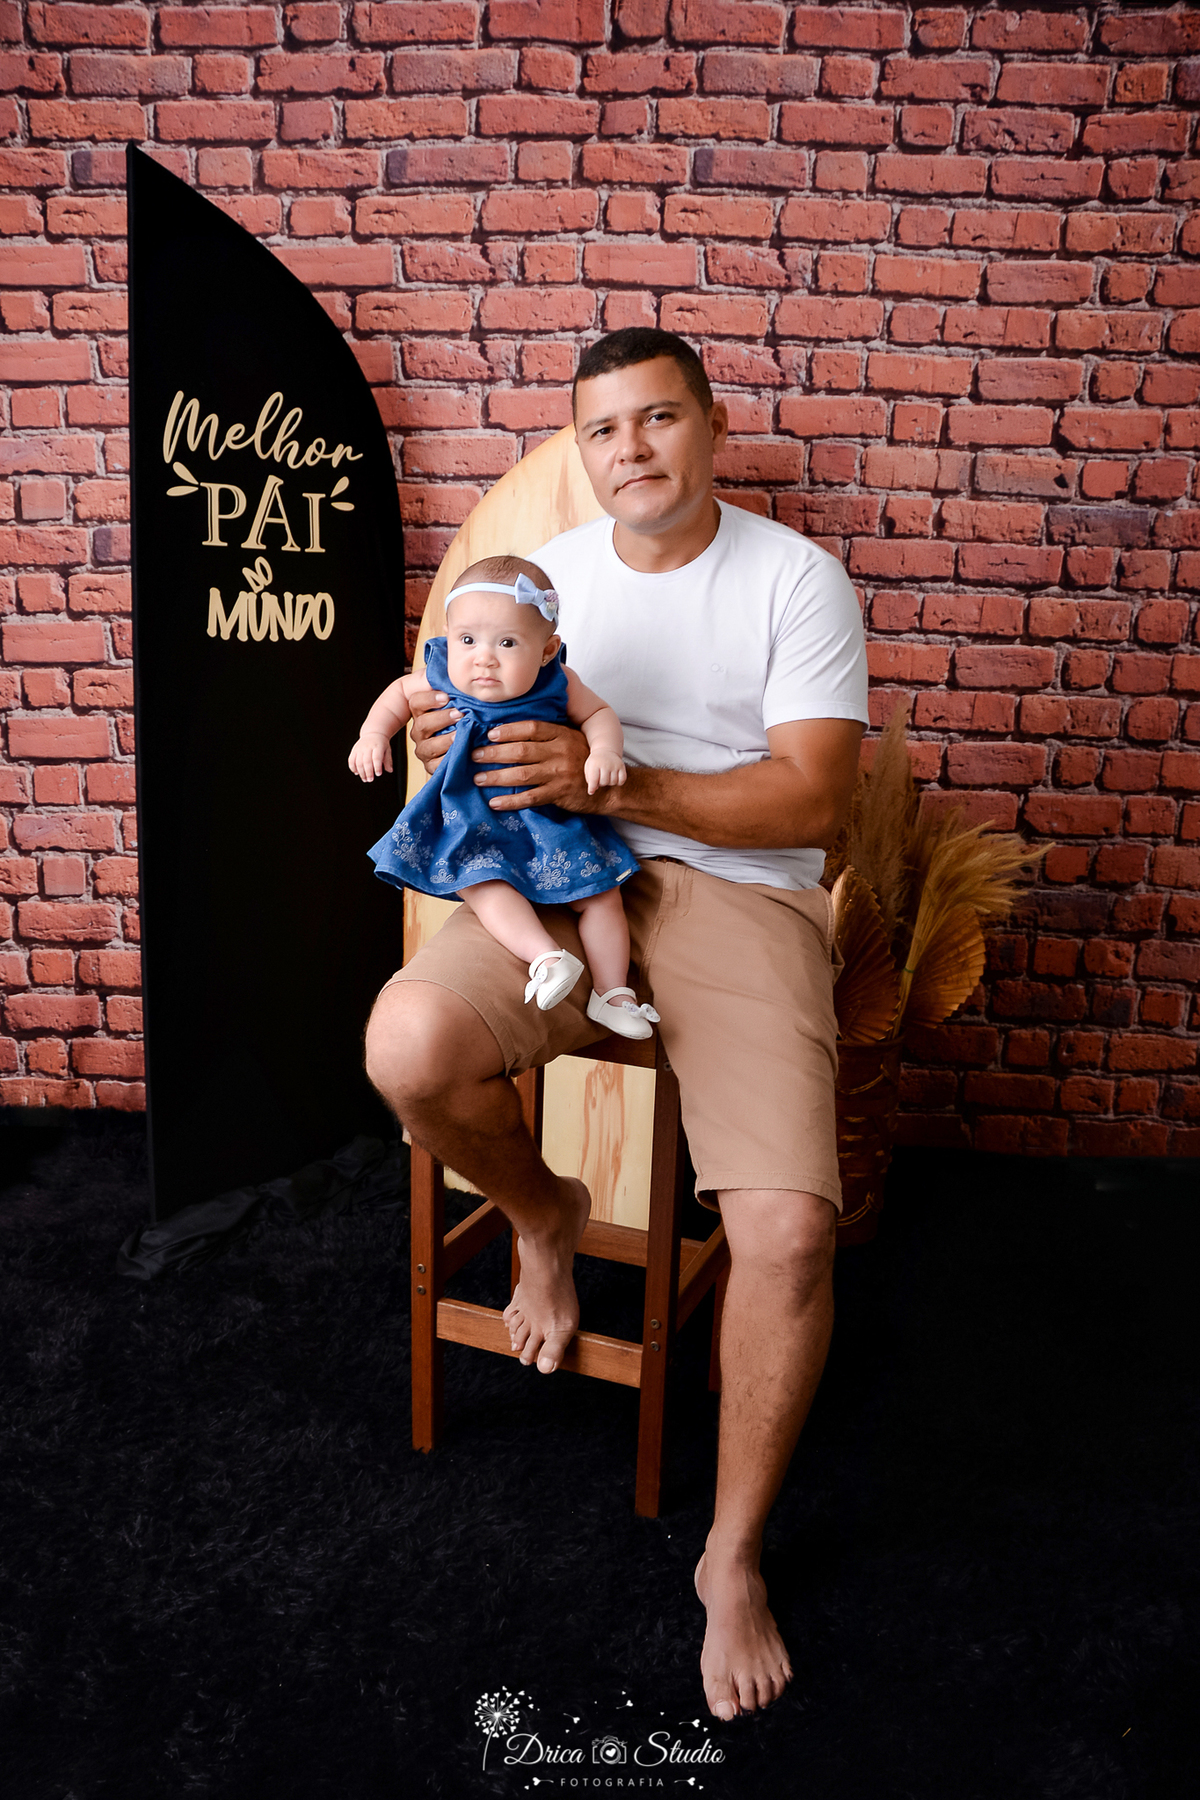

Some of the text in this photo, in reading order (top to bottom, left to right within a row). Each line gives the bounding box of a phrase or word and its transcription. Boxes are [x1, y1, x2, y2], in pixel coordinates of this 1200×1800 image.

[162, 390, 364, 470] Melhor
[200, 474, 326, 553] PAI
[206, 587, 335, 642] MUNDO
